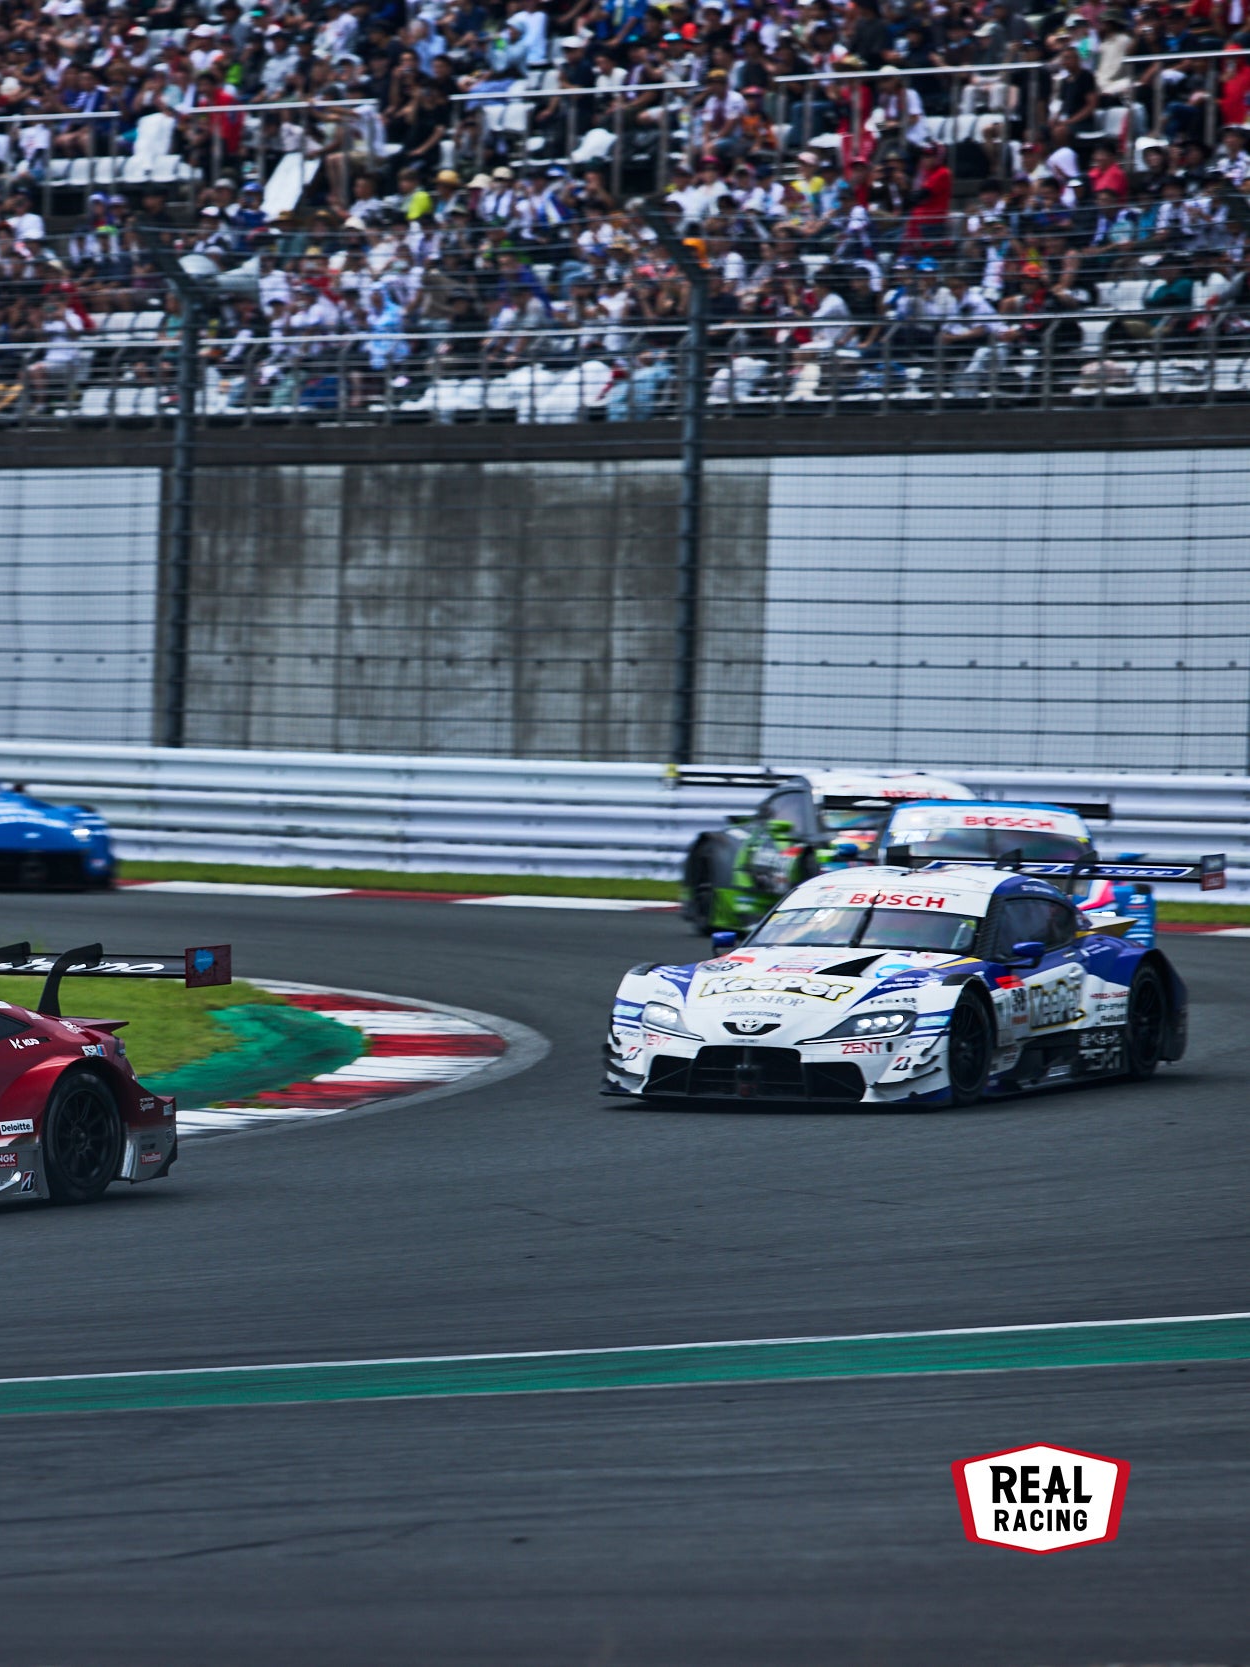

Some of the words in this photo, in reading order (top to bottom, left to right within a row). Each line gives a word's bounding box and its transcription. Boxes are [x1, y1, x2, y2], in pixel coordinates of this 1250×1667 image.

[963, 816, 1056, 829] BOSCH
[848, 893, 946, 908] BOSCH
[699, 975, 855, 1002] KeePer
[720, 994, 754, 1006] PRO
[762, 994, 806, 1007] SHOP
[840, 1041, 883, 1055] ZENT
